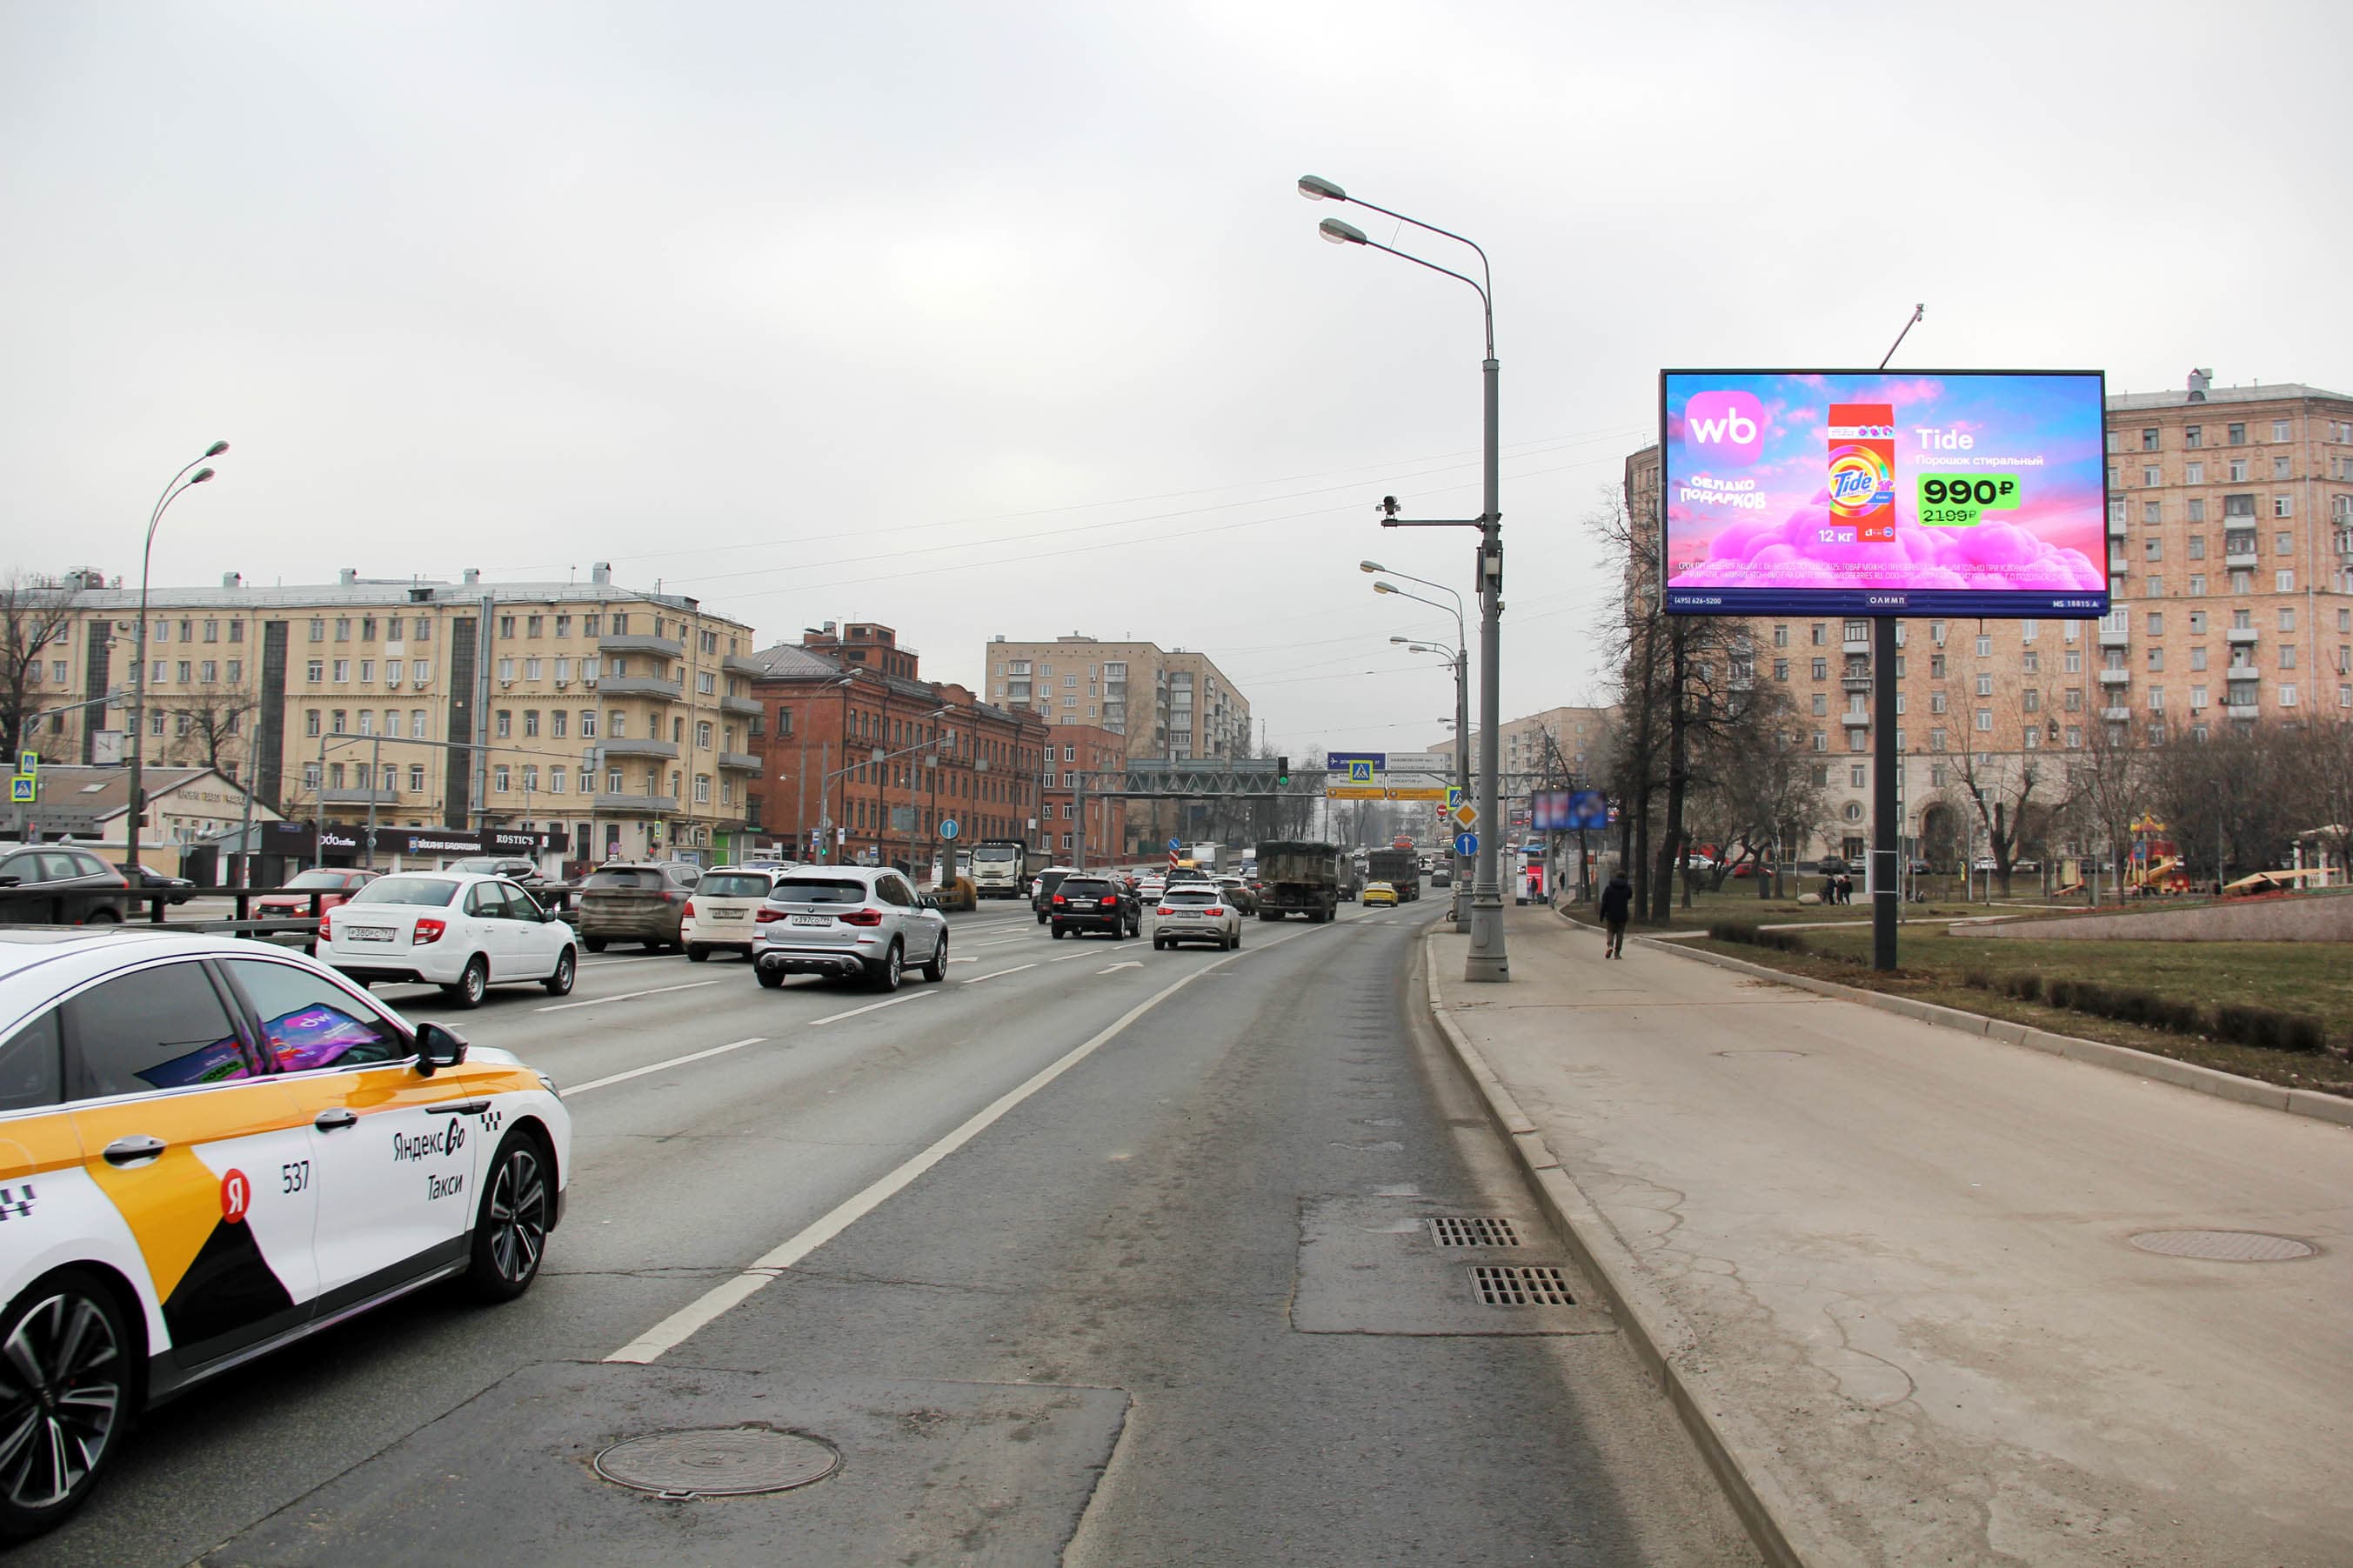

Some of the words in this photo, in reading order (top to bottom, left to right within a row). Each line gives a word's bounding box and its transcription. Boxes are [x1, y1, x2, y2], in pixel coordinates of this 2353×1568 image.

[1689, 407, 1757, 444] wb
[1915, 429, 1975, 450] Tide
[1915, 454, 1970, 466] Порошок
[1973, 455, 2044, 467] стиральный
[1691, 476, 1755, 491] ОБЛАКО
[1833, 470, 1873, 498] Tide
[1680, 487, 1767, 510] ПОДАРКОВ
[1817, 530, 1835, 543] 12
[1838, 532, 1854, 543] кг
[496, 834, 534, 845] ROSTIC'S
[393, 1131, 445, 1162] Яндекс
[445, 1118, 465, 1157] Go
[282, 1159, 310, 1194] 537
[427, 1173, 464, 1201] Такси
[228, 1177, 244, 1215] Я
